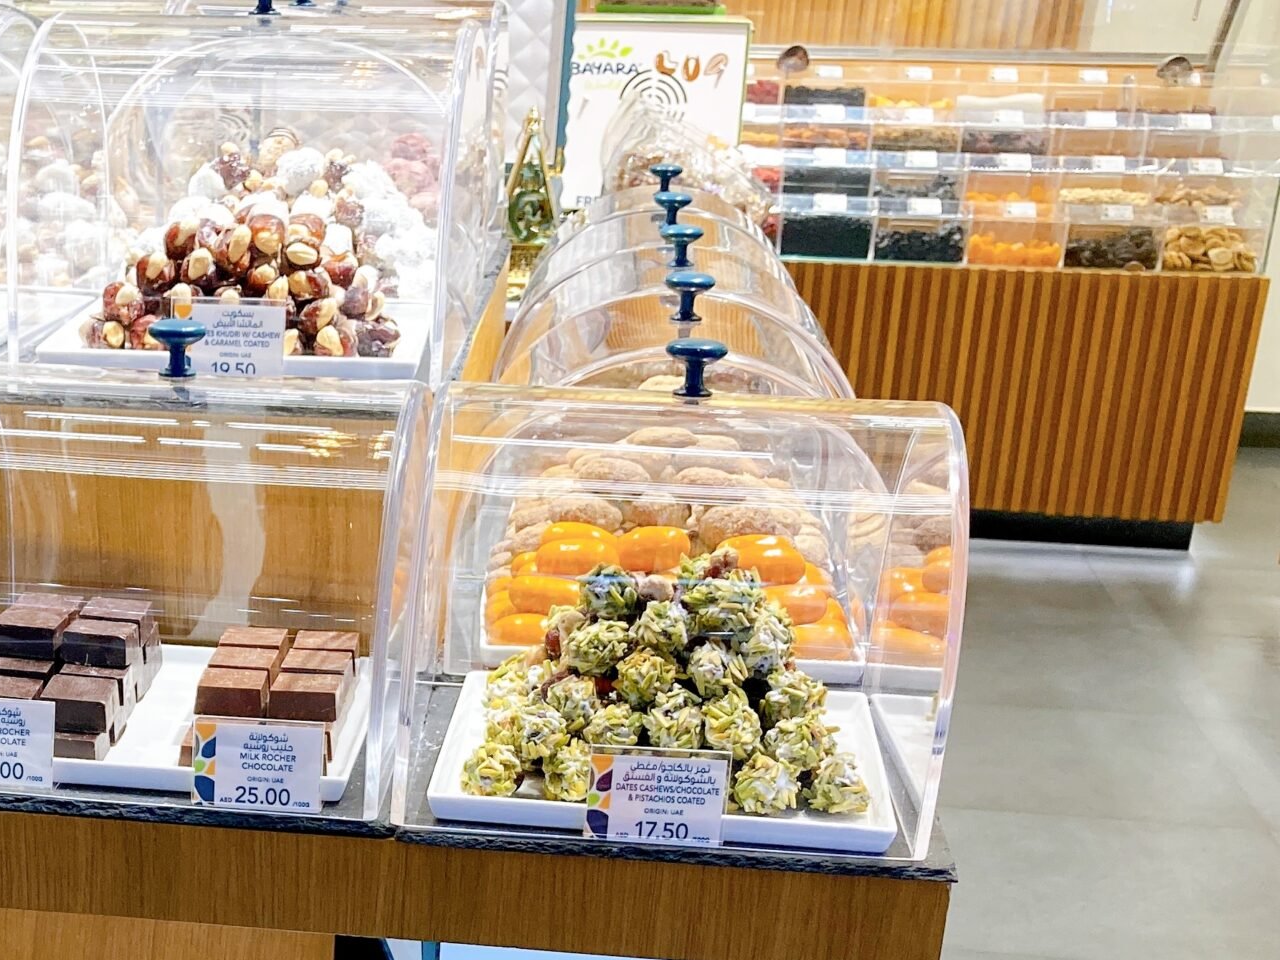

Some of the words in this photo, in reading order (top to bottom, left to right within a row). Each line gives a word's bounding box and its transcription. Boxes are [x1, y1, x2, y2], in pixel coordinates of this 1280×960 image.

[216, 330, 240, 338] KHUDRI
[210, 339, 241, 347] CARAMEL
[243, 340, 270, 348] COATED
[239, 752, 260, 761] MILK
[261, 753, 297, 763] ROCHER
[241, 761, 294, 772] CHOCOLATE
[694, 763, 711, 774] تمر
[615, 782, 638, 791] DATES
[639, 784, 720, 796] CASHEWS/CHOCOLATE
[234, 786, 291, 806] 25.00
[634, 794, 675, 804] PISTACHIOS
[676, 796, 706, 805] COATED
[670, 808, 684, 816] UAE
[634, 820, 689, 841] 17.50
